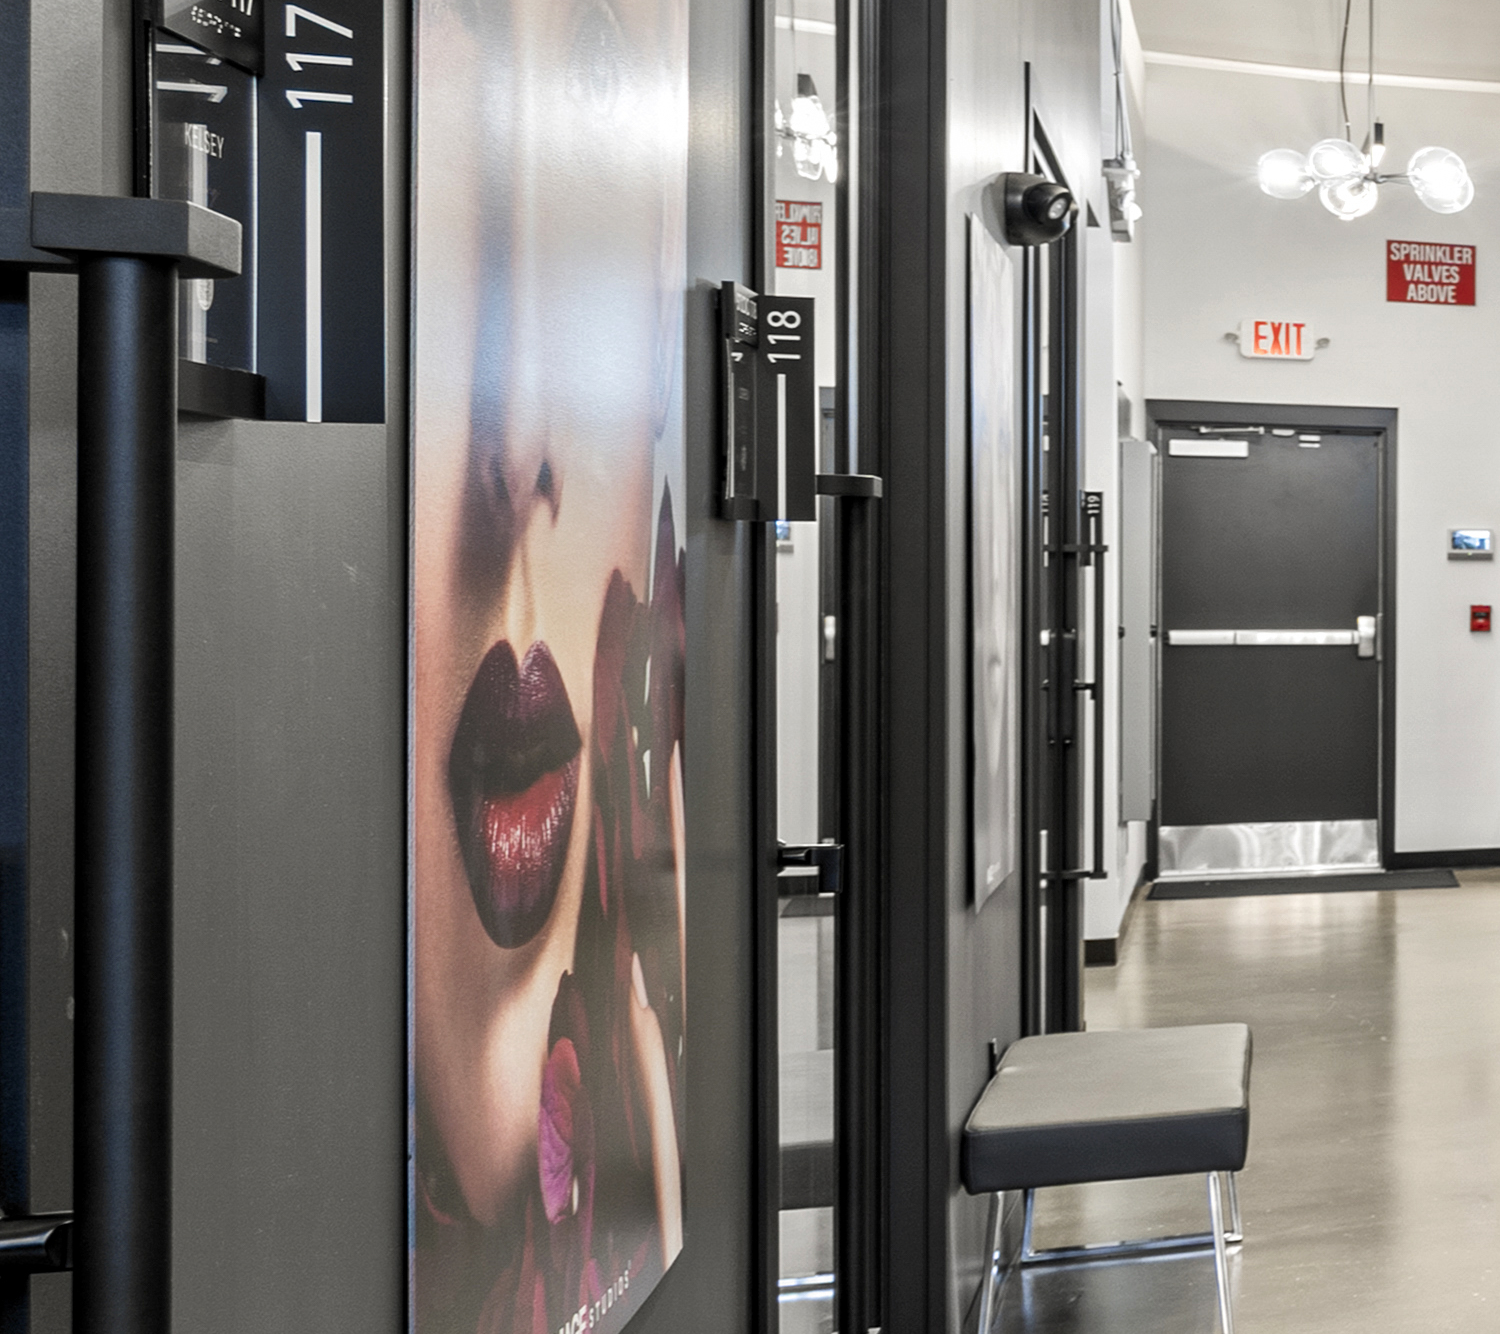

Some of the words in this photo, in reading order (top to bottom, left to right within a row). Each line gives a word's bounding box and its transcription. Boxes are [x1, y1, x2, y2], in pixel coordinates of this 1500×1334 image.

[285, 3, 354, 109] 117
[184, 121, 225, 159] KELSEY
[1390, 242, 1473, 265] SPRINKLER
[1402, 264, 1460, 284] VALVES
[1406, 284, 1457, 304] ABOVE
[767, 310, 801, 364] 118
[1253, 320, 1306, 356] EXIT
[1087, 495, 1100, 514] 119
